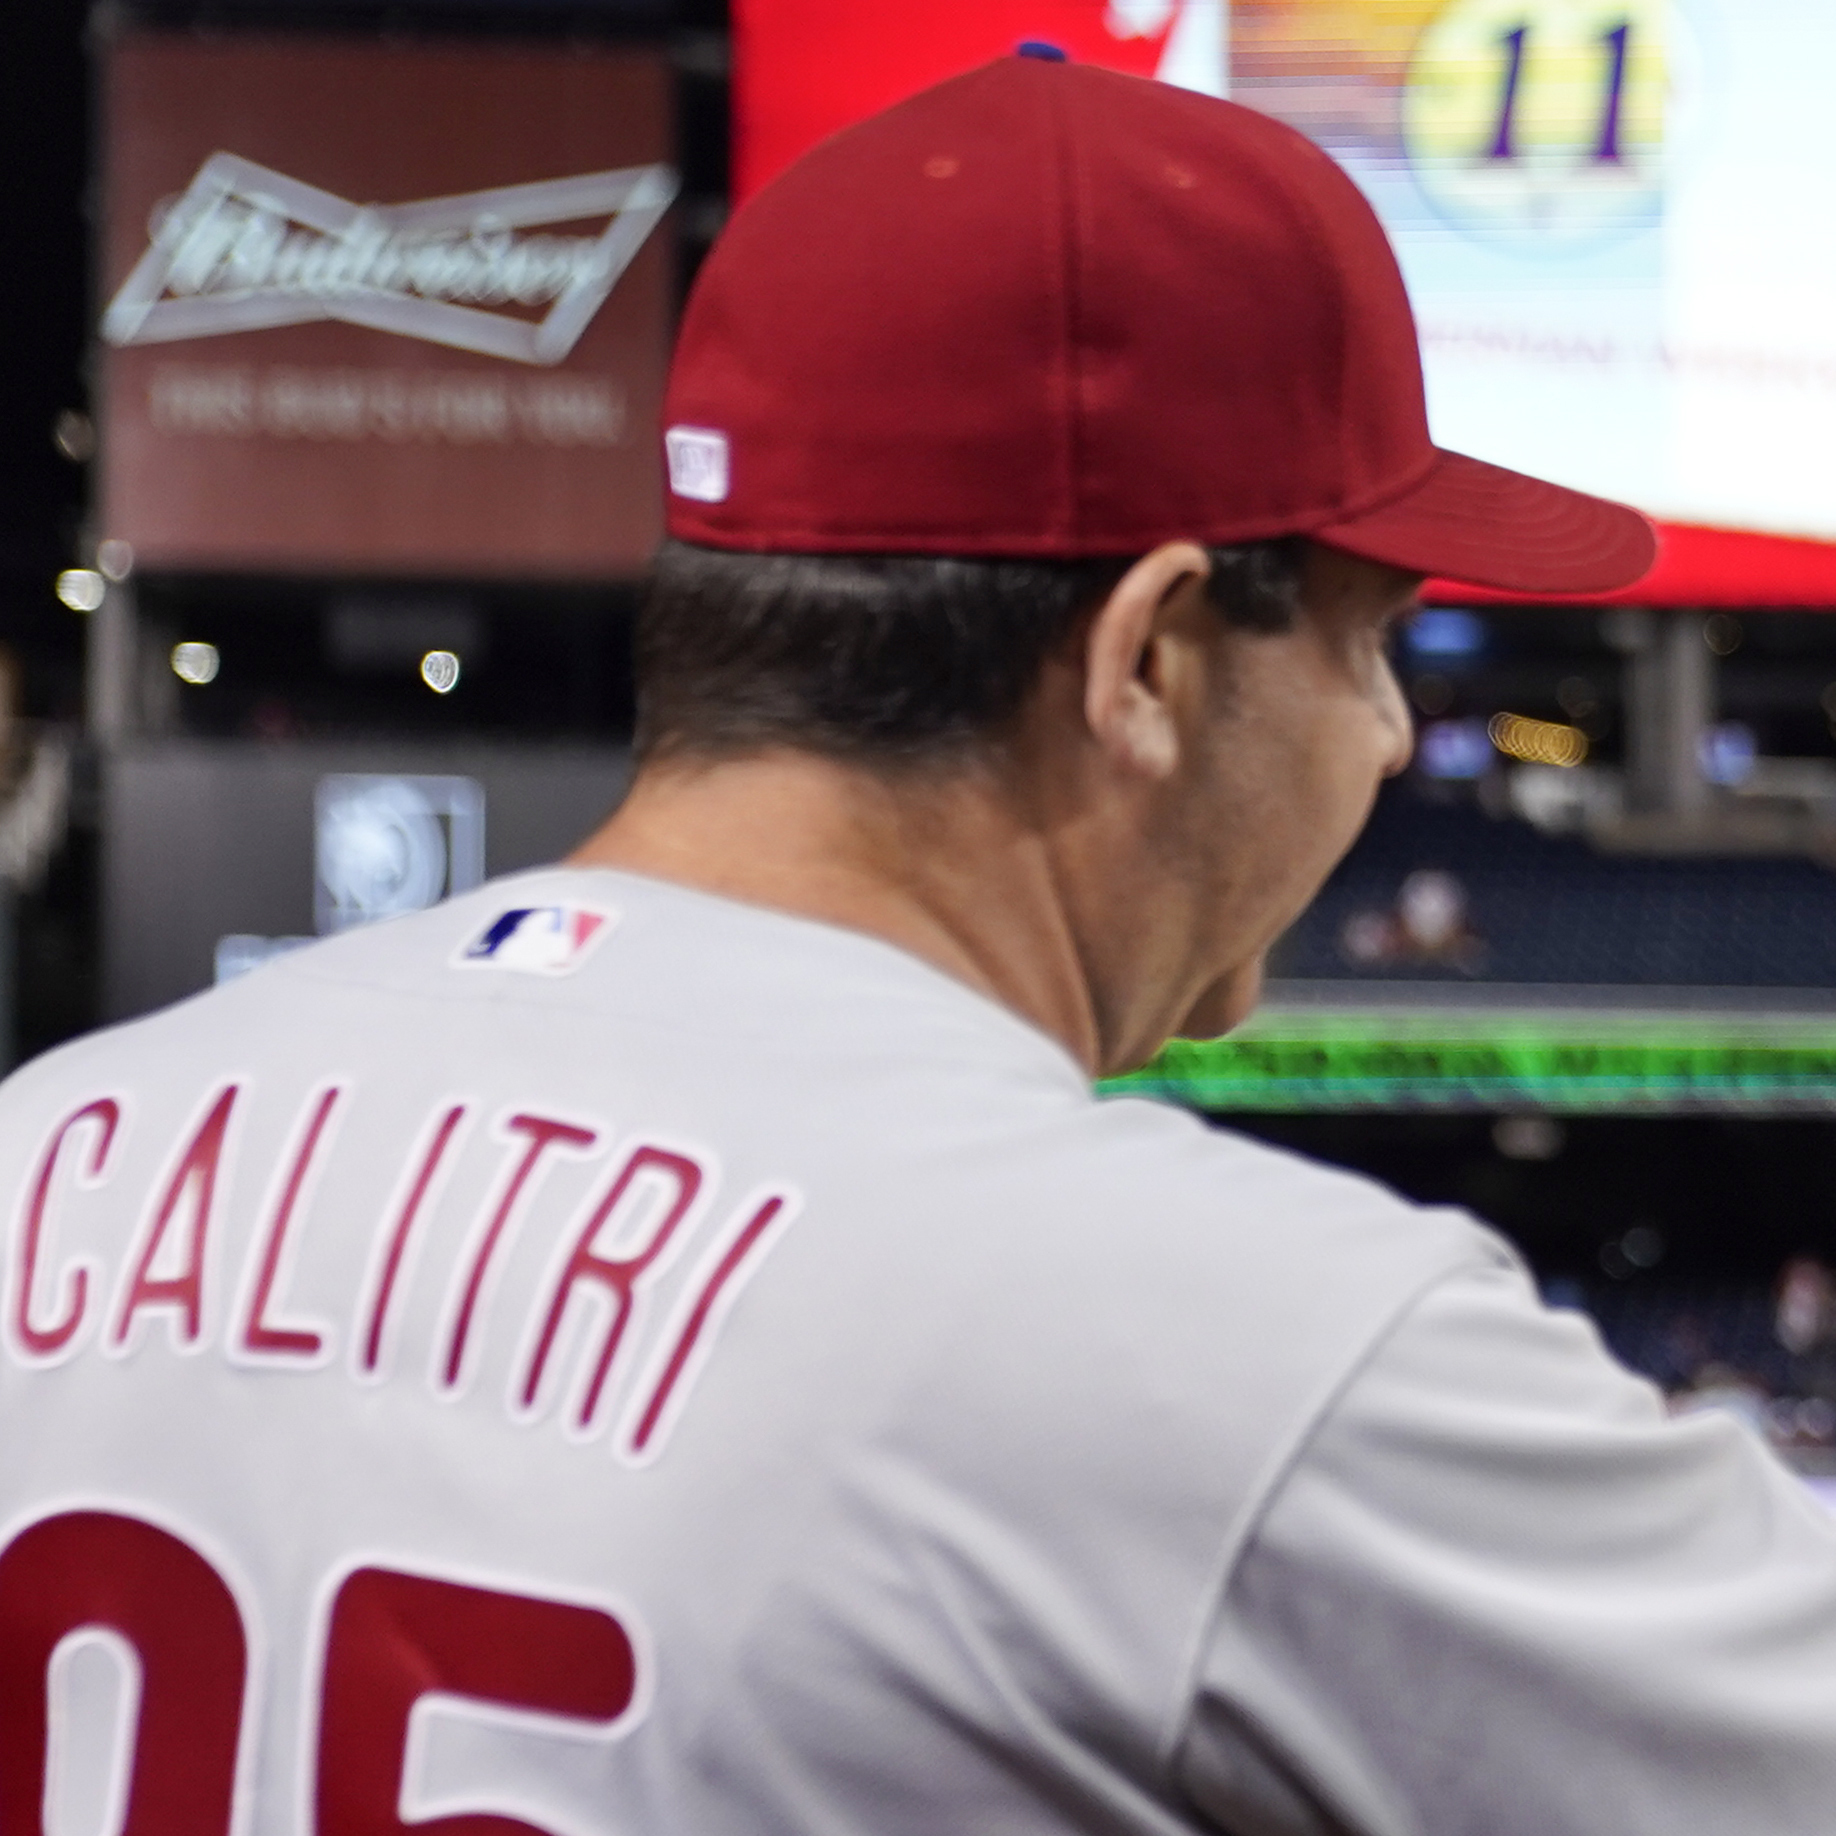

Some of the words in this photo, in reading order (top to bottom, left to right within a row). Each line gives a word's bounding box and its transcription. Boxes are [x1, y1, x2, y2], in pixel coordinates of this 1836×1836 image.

[1486, 20, 1630, 159] 11
[150, 195, 607, 305] Budweiser
[10, 1079, 792, 1458] CALITRI
